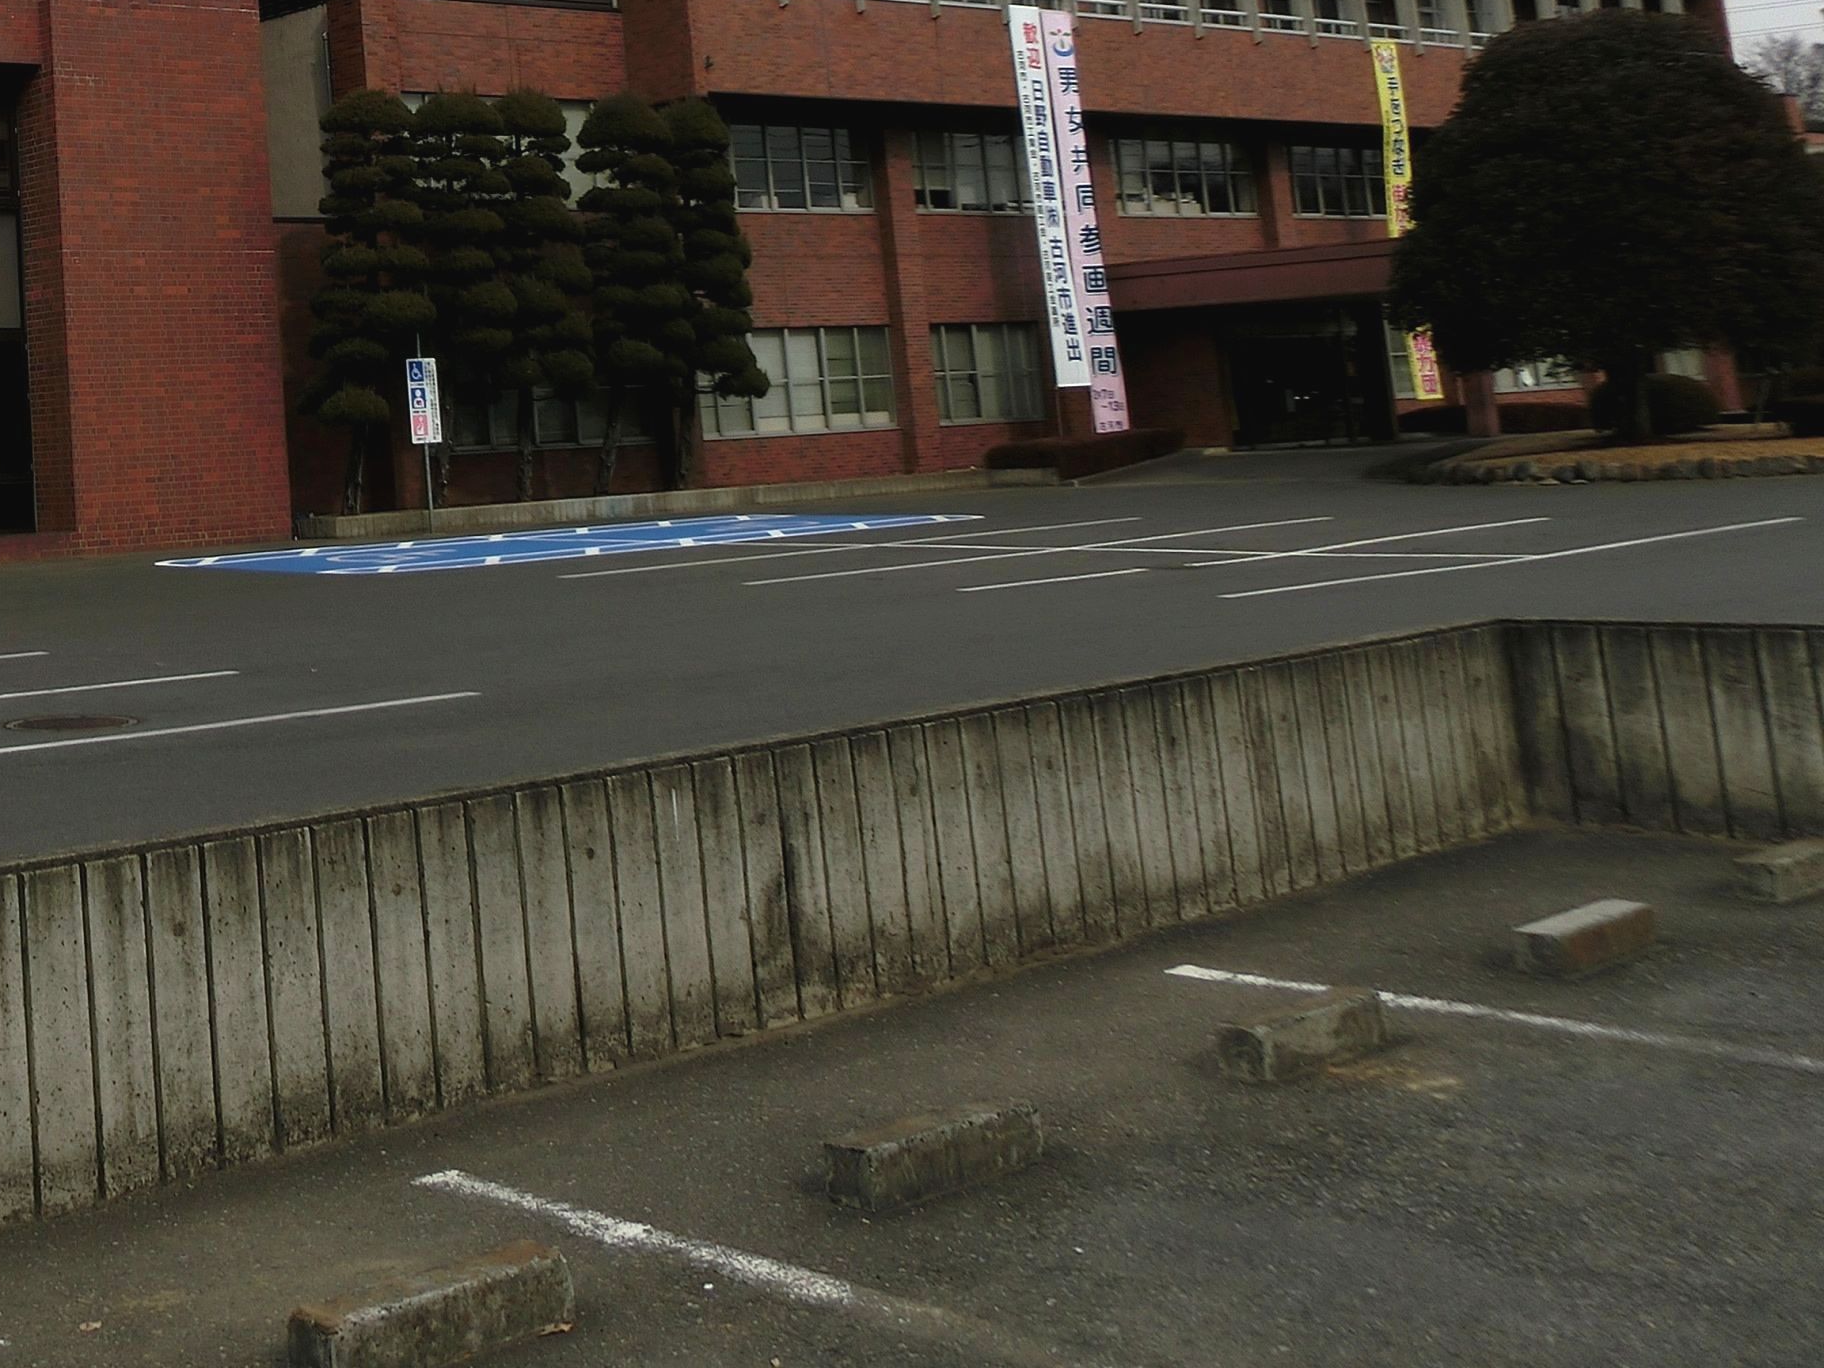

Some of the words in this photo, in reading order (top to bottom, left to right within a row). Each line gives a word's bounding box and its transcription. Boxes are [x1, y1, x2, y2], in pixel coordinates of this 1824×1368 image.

[1057, 67, 1119, 376] 男女共同参画週間
